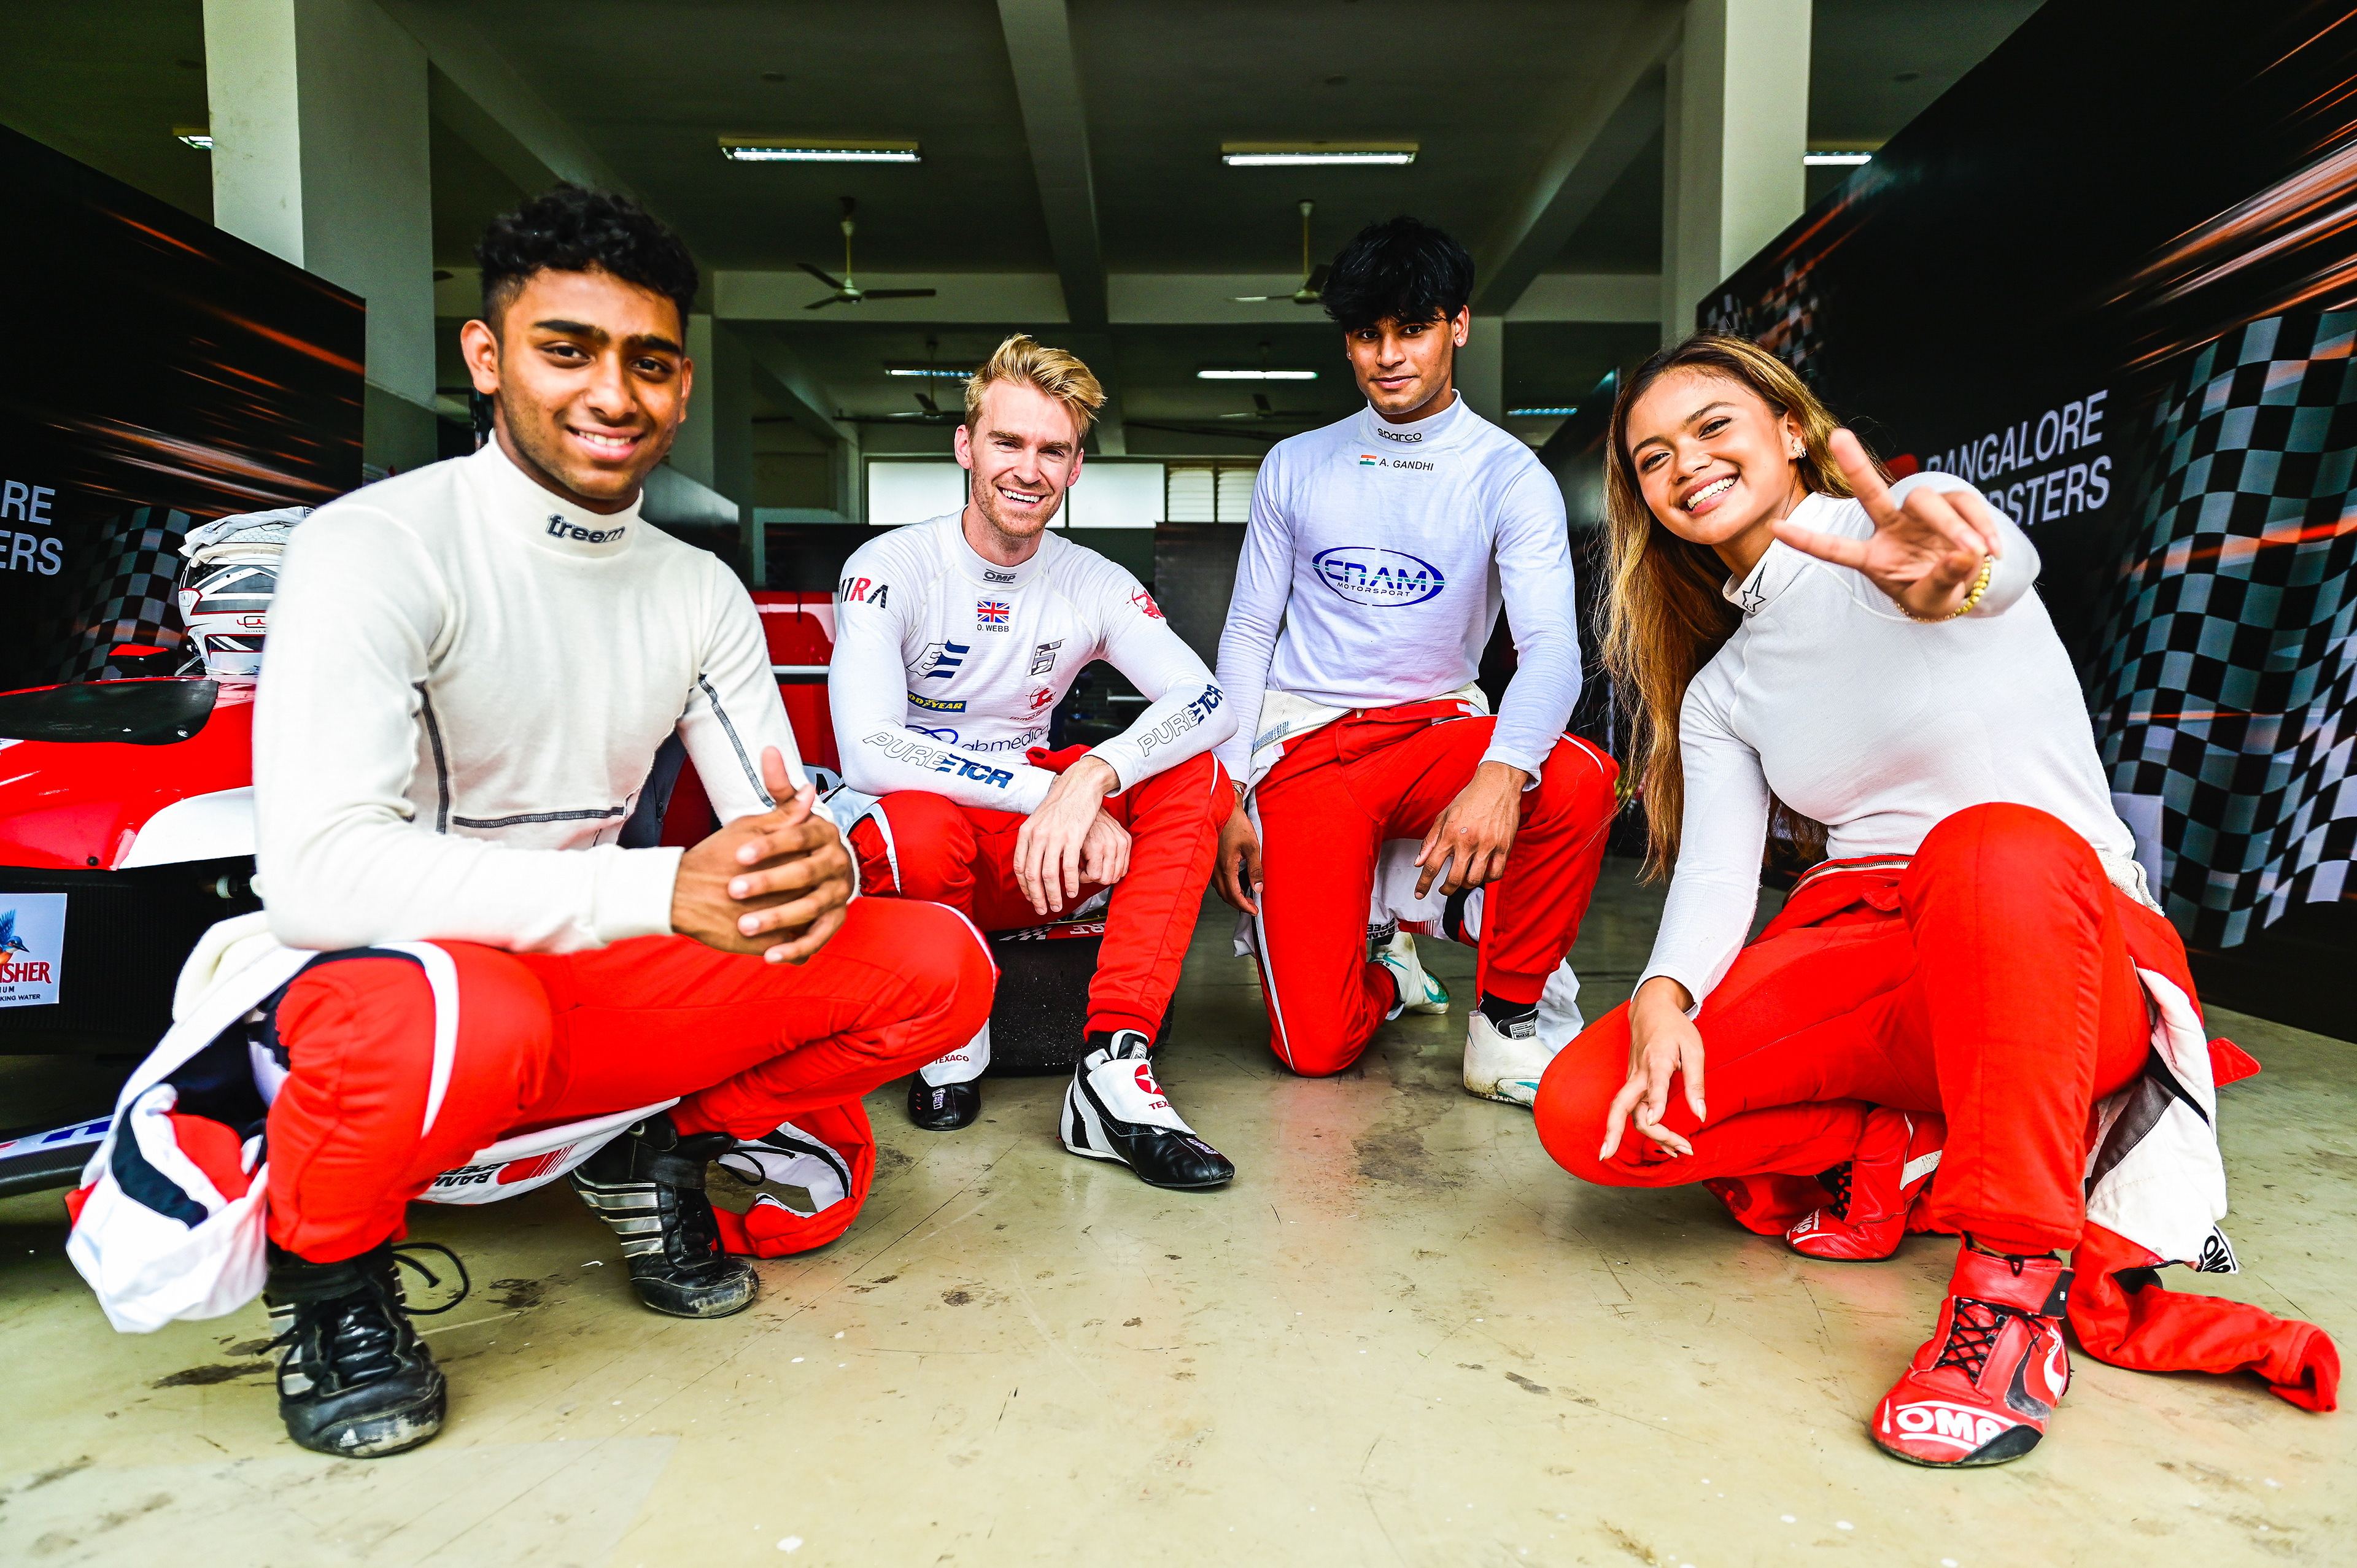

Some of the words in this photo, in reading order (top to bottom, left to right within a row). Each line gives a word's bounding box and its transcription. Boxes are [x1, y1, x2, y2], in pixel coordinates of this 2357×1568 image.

[1377, 428, 1422, 442] sparco
[1379, 458, 1389, 467] A.
[1393, 460, 1434, 471] GANDHI
[545, 513, 626, 544] freem
[983, 571, 1016, 582] OMP
[1337, 582, 1411, 597] MOTORSPORT
[935, 1054, 969, 1065] TEXACO
[1896, 1407, 2002, 1445] OMP
